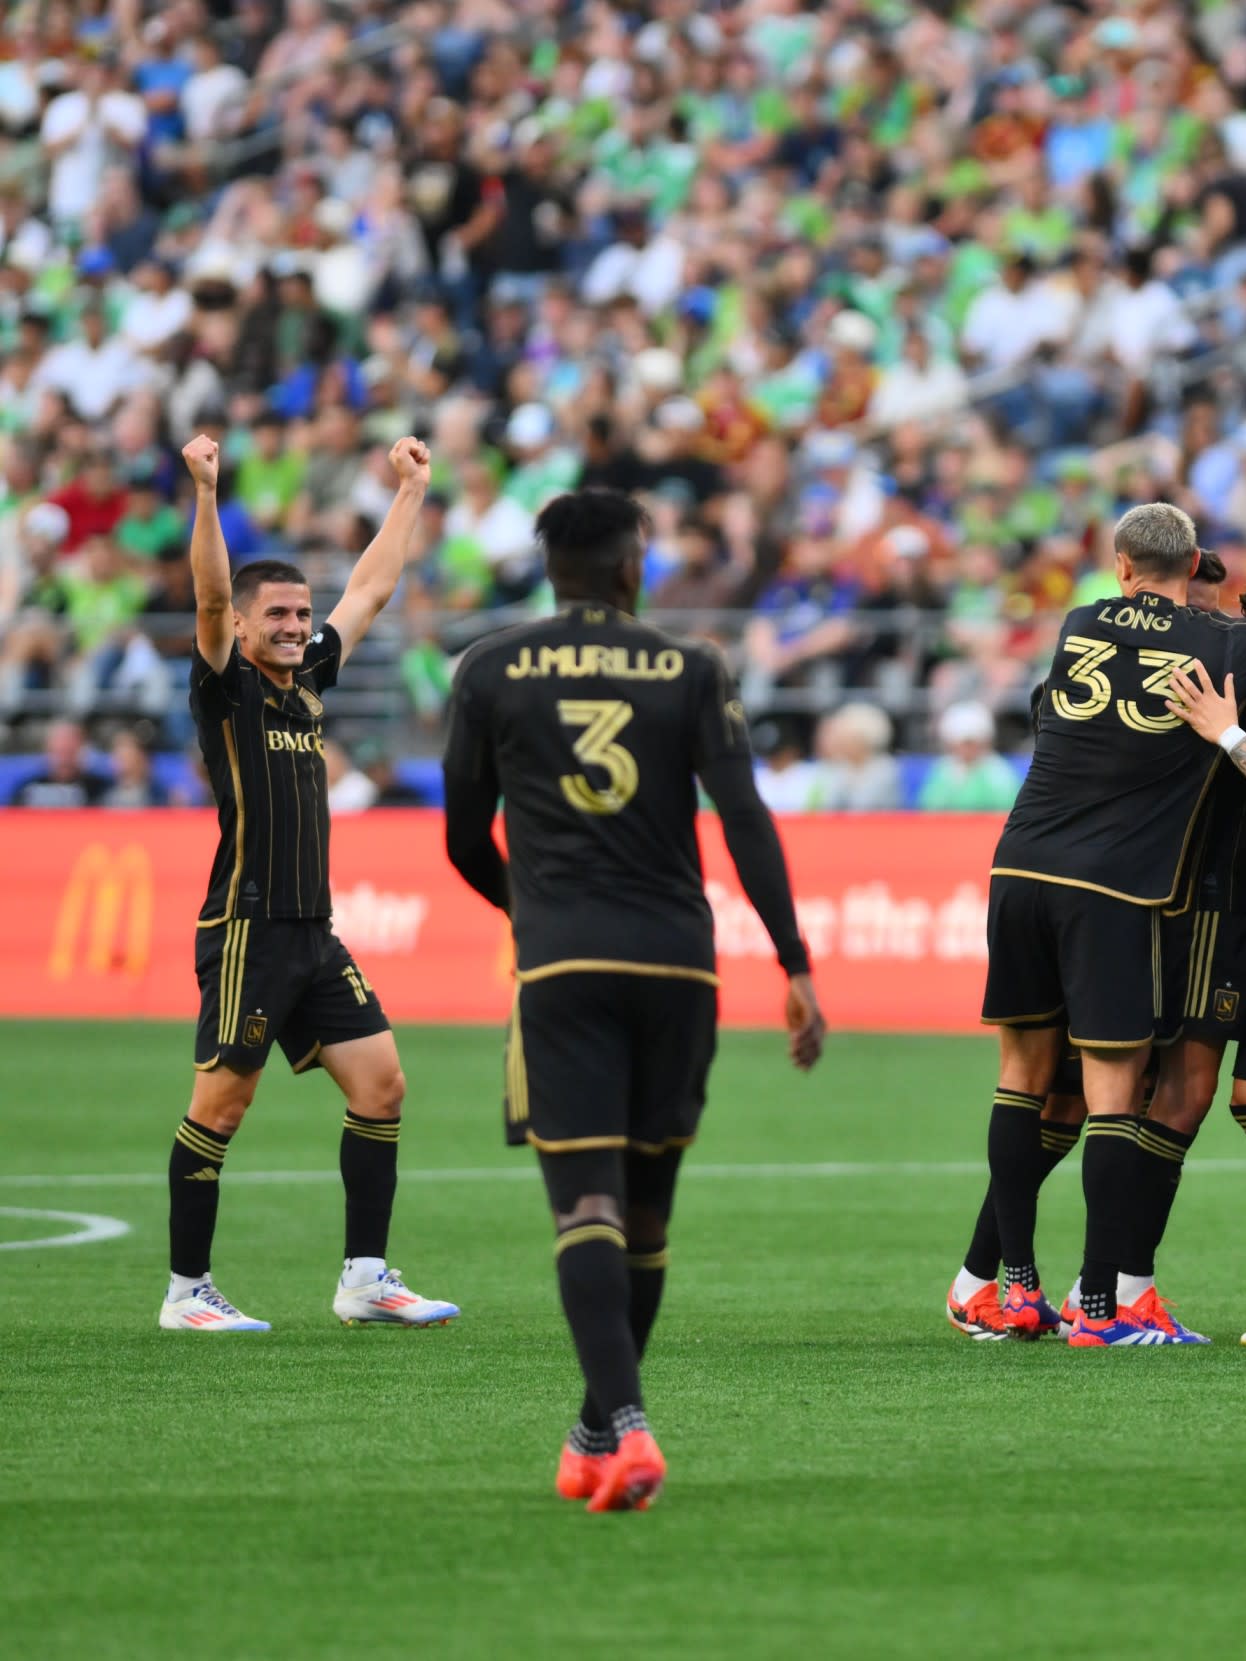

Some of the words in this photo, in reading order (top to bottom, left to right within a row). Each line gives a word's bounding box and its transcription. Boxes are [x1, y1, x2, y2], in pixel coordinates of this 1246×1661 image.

[1097, 606, 1173, 632] LONG
[506, 644, 684, 681] J.MURILLO
[1051, 635, 1198, 734] 33
[557, 699, 640, 815] 3
